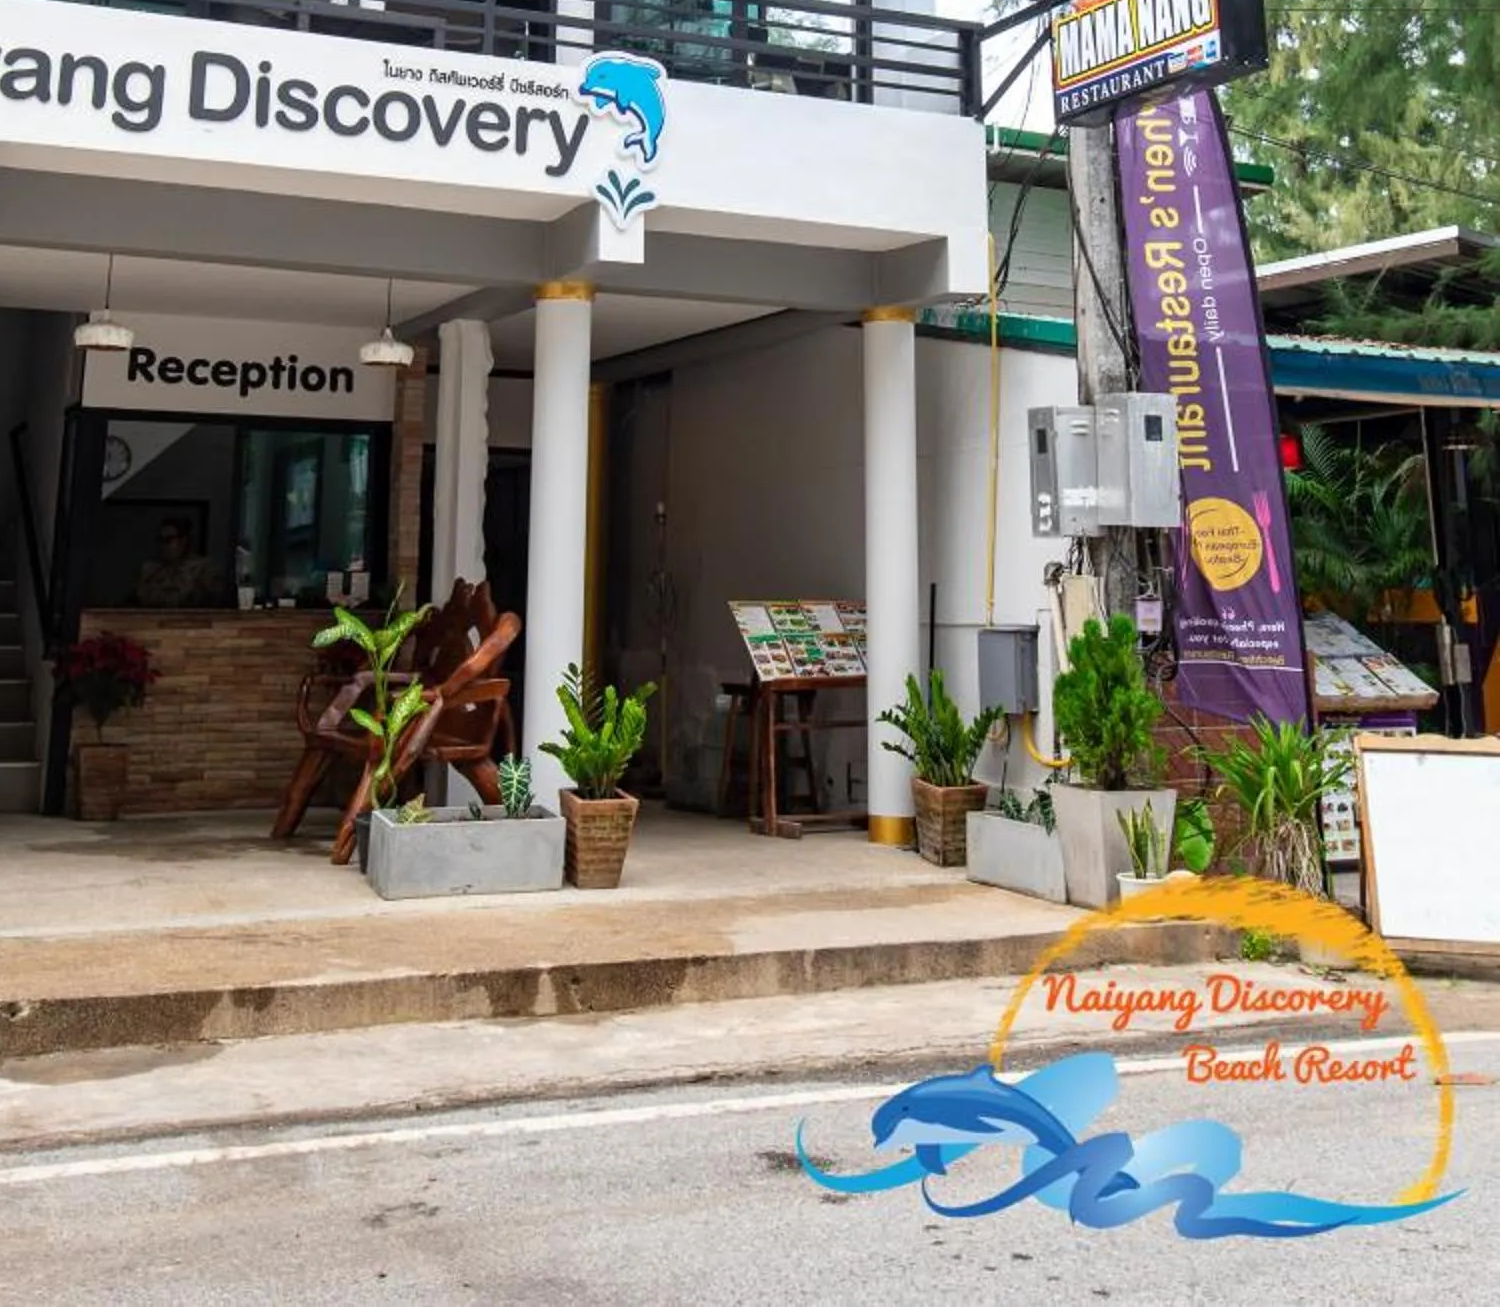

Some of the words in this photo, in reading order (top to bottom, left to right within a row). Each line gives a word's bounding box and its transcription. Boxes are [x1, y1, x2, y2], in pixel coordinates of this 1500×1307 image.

[188, 50, 590, 178] Discovery
[1060, 60, 1166, 114] RESTAURANT
[127, 345, 355, 397] Reception
